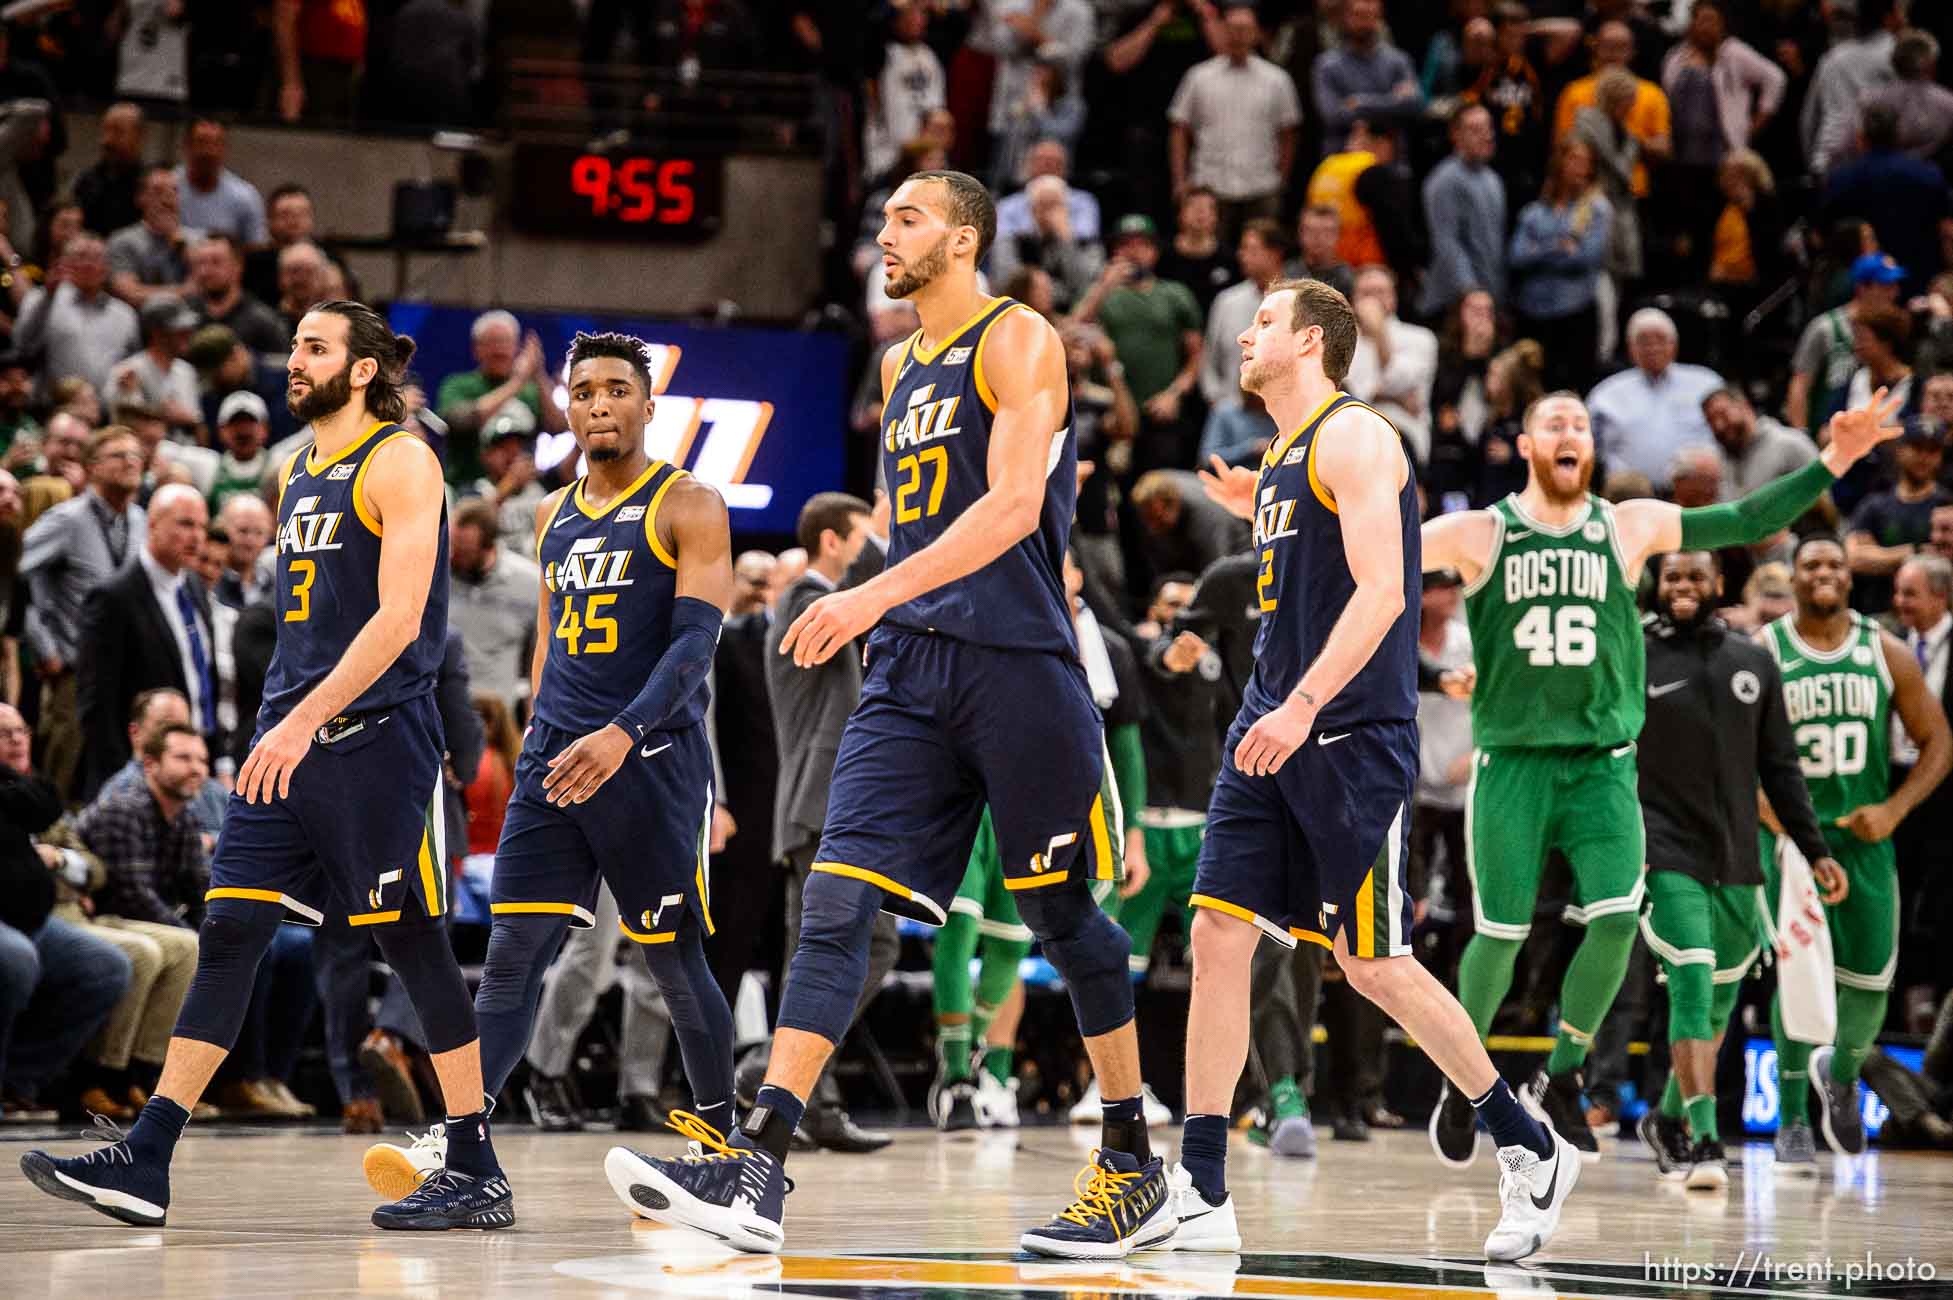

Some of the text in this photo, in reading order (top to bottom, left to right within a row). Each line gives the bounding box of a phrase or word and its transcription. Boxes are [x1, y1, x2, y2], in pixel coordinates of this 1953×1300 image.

[571, 154, 695, 224] 9:55
[884, 383, 961, 453] JAZZ
[896, 445, 949, 524] 27
[284, 559, 316, 623] 3
[544, 536, 635, 592] JAZZ
[1256, 548, 1278, 612] 2
[1504, 547, 1608, 604] BOSTON
[555, 593, 619, 655] 45
[1512, 604, 1598, 667] 46
[1782, 672, 1878, 725] BOSTON
[1794, 721, 1868, 778] 30
